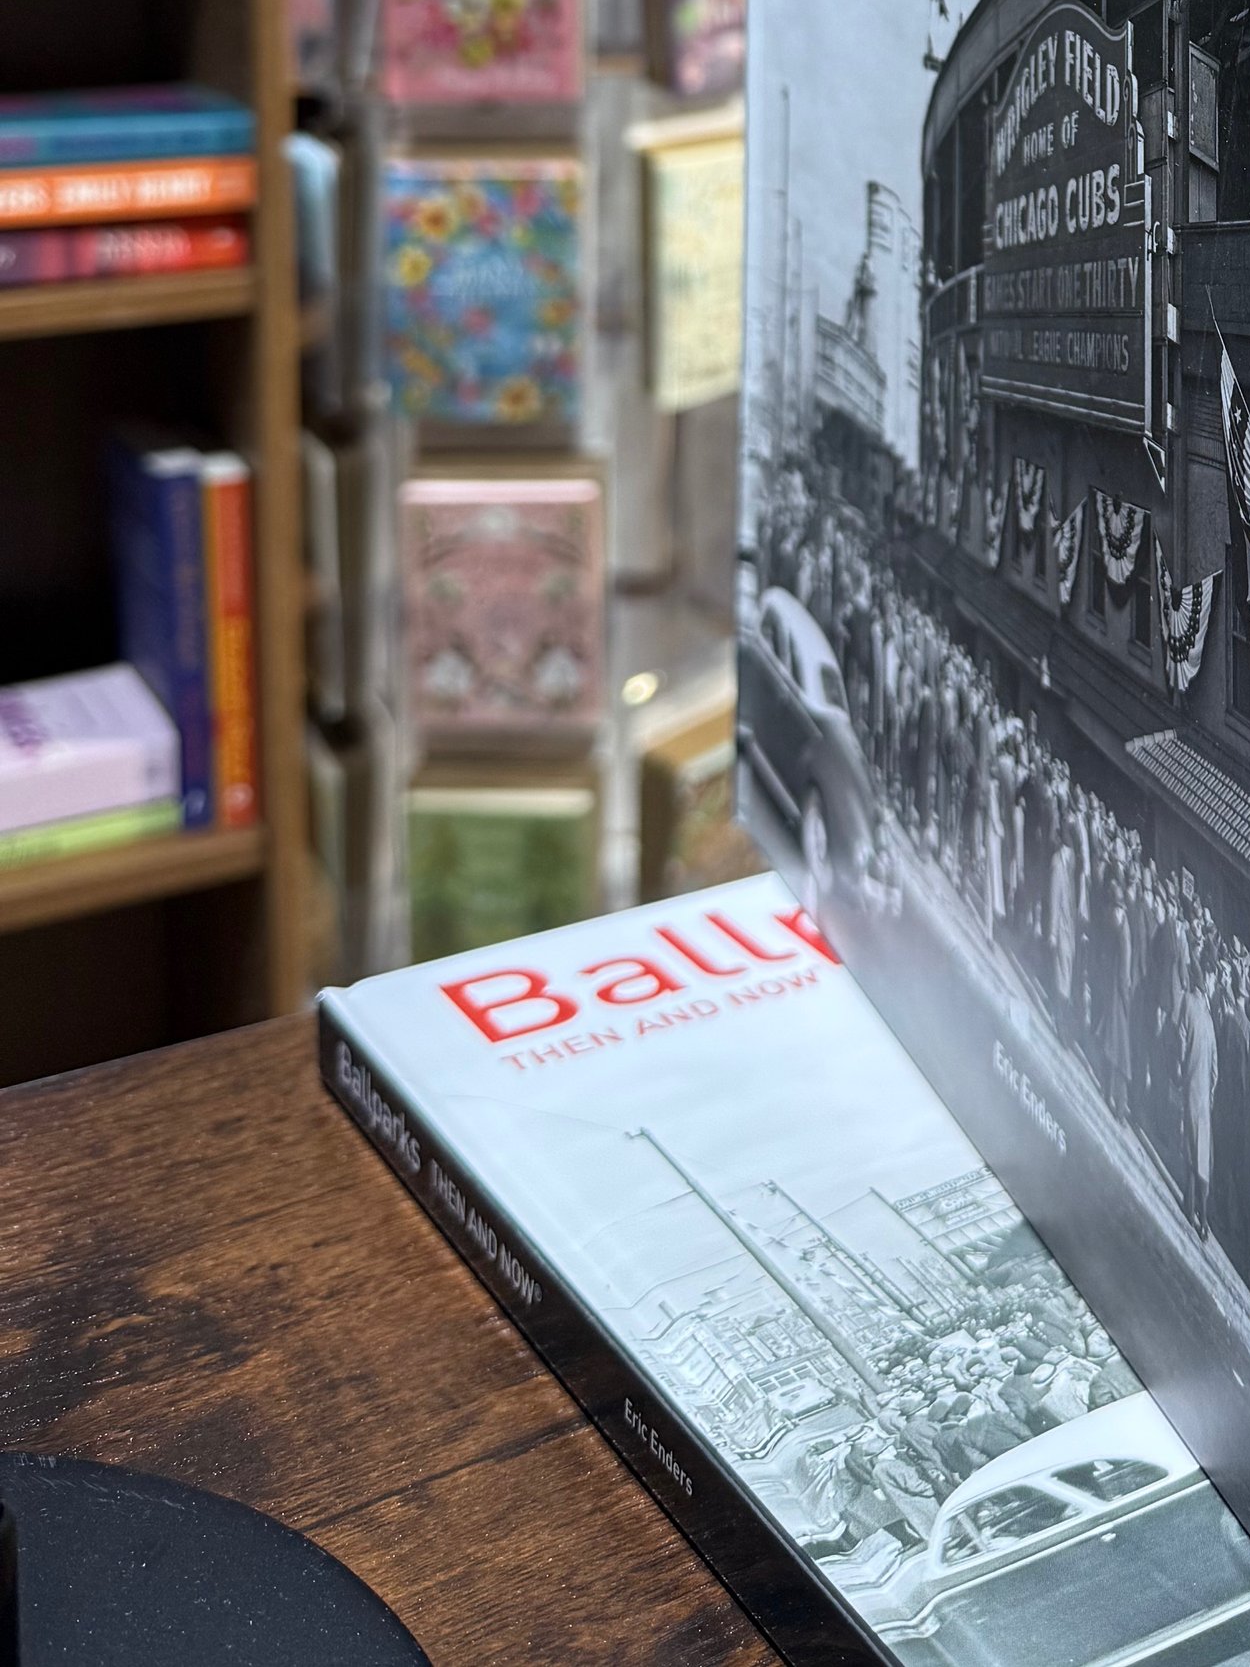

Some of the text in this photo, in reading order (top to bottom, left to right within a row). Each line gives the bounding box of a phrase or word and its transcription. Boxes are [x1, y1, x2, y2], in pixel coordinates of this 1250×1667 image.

[1065, 30, 1120, 127] FIELD
[1023, 110, 1079, 166] HOME OF
[995, 163, 1121, 249] CHICAGO CUBS
[1083, 256, 1139, 308] THIRTY
[1067, 332, 1129, 373] CHAMPIONS
[500, 966, 819, 1071] THEN AND NOW
[993, 1039, 1067, 1155] Eric Enders
[337, 1040, 421, 1175] Ballparks
[429, 1158, 466, 1224] THEN
[467, 1207, 497, 1260] AND
[624, 1397, 693, 1497] Eric Enders
